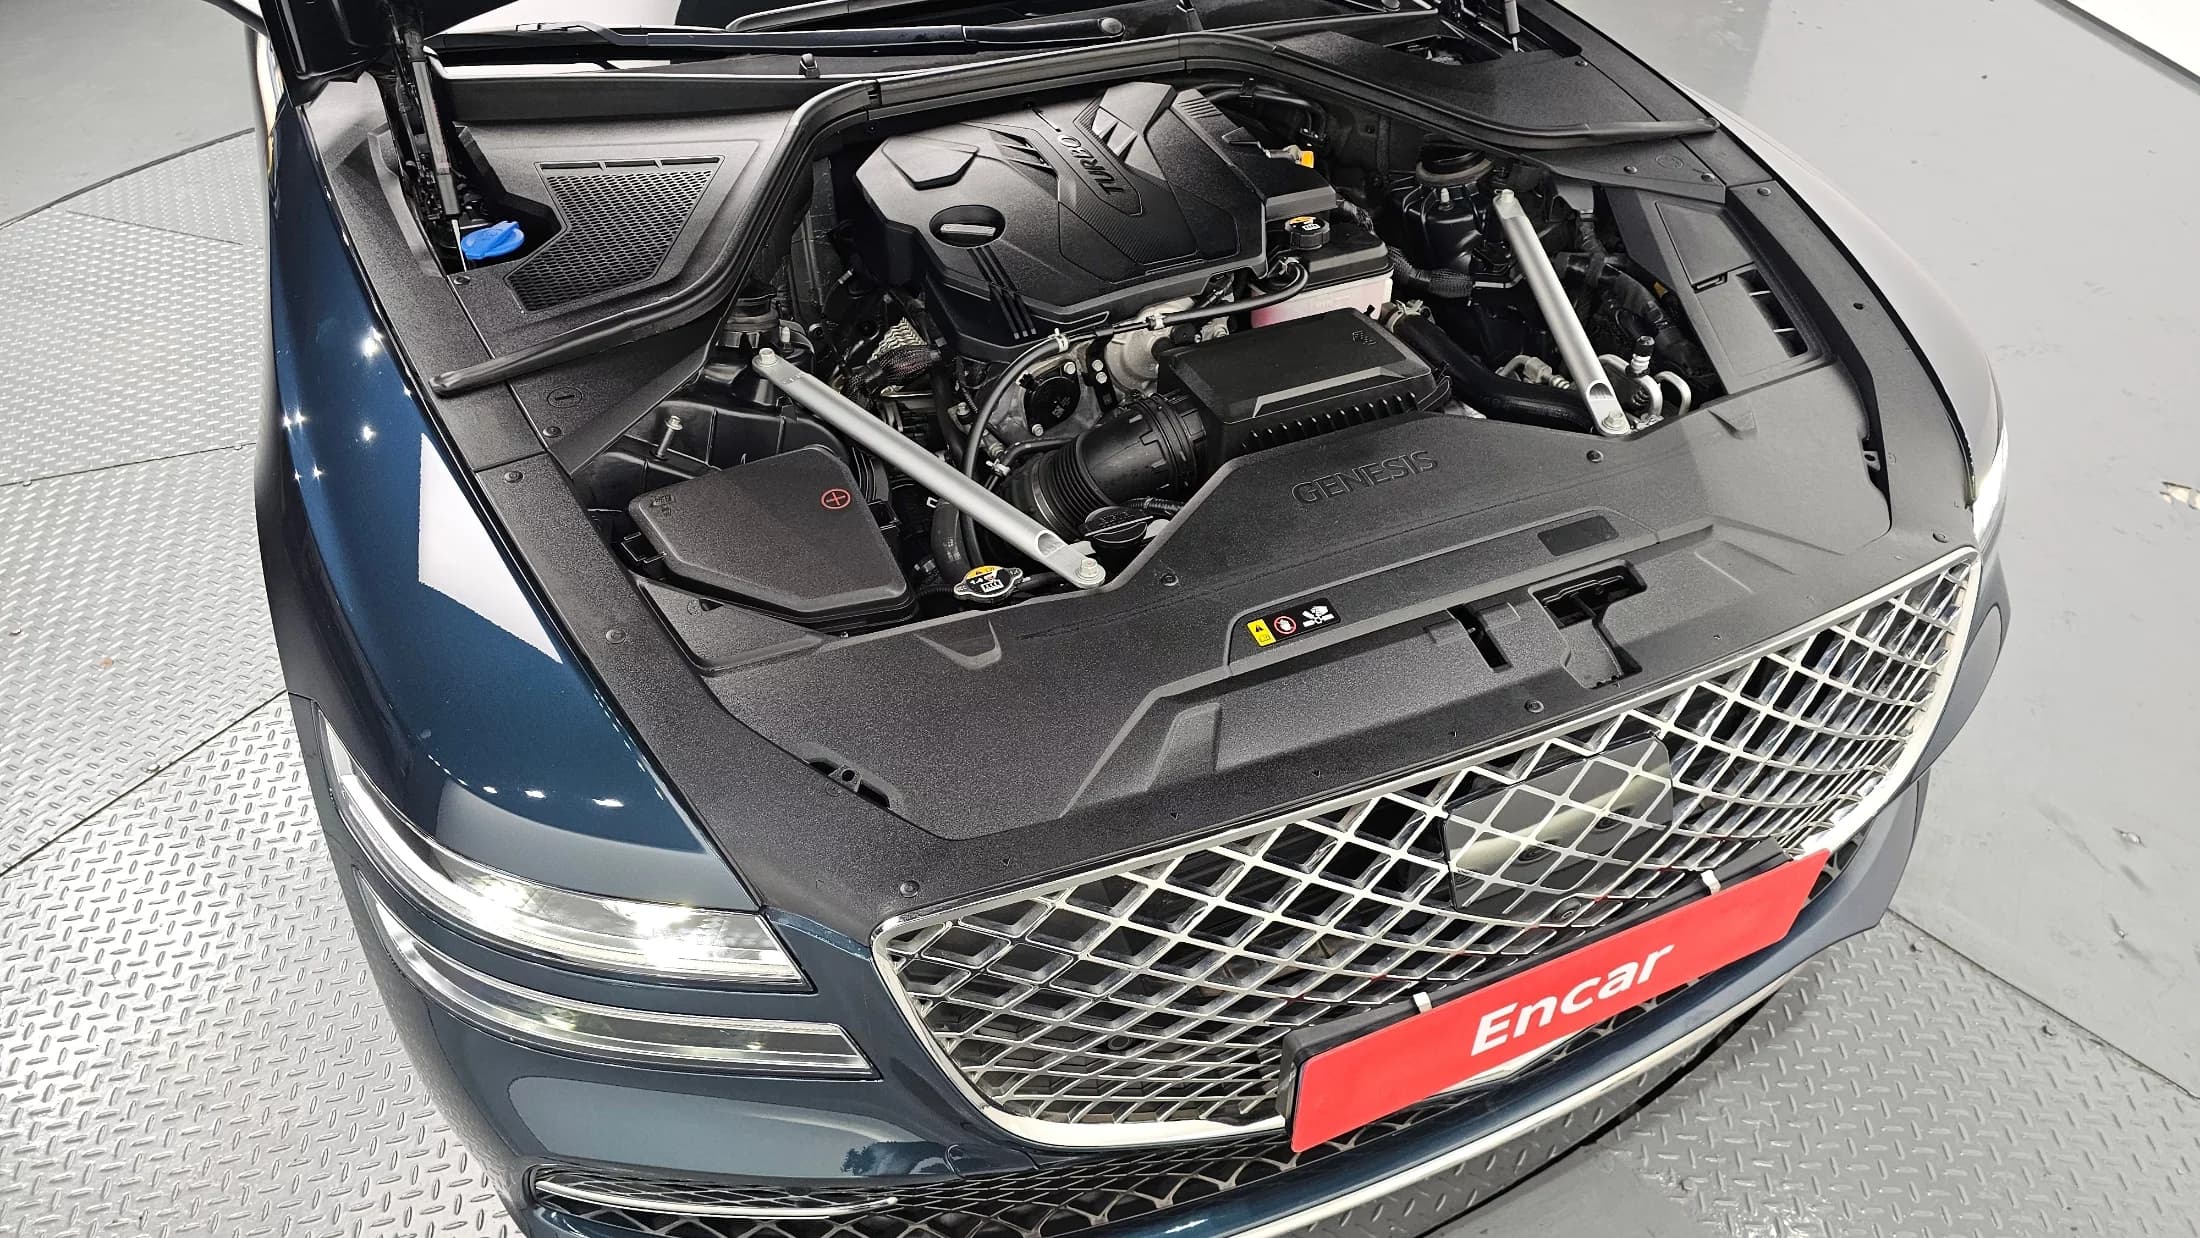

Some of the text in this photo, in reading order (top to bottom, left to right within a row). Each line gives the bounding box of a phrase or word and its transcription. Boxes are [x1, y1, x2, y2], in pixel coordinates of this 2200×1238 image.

[1060, 135, 1124, 195] TURBO
[1291, 450, 1438, 502] GENESIS
[1471, 944, 1676, 1056] Encar
